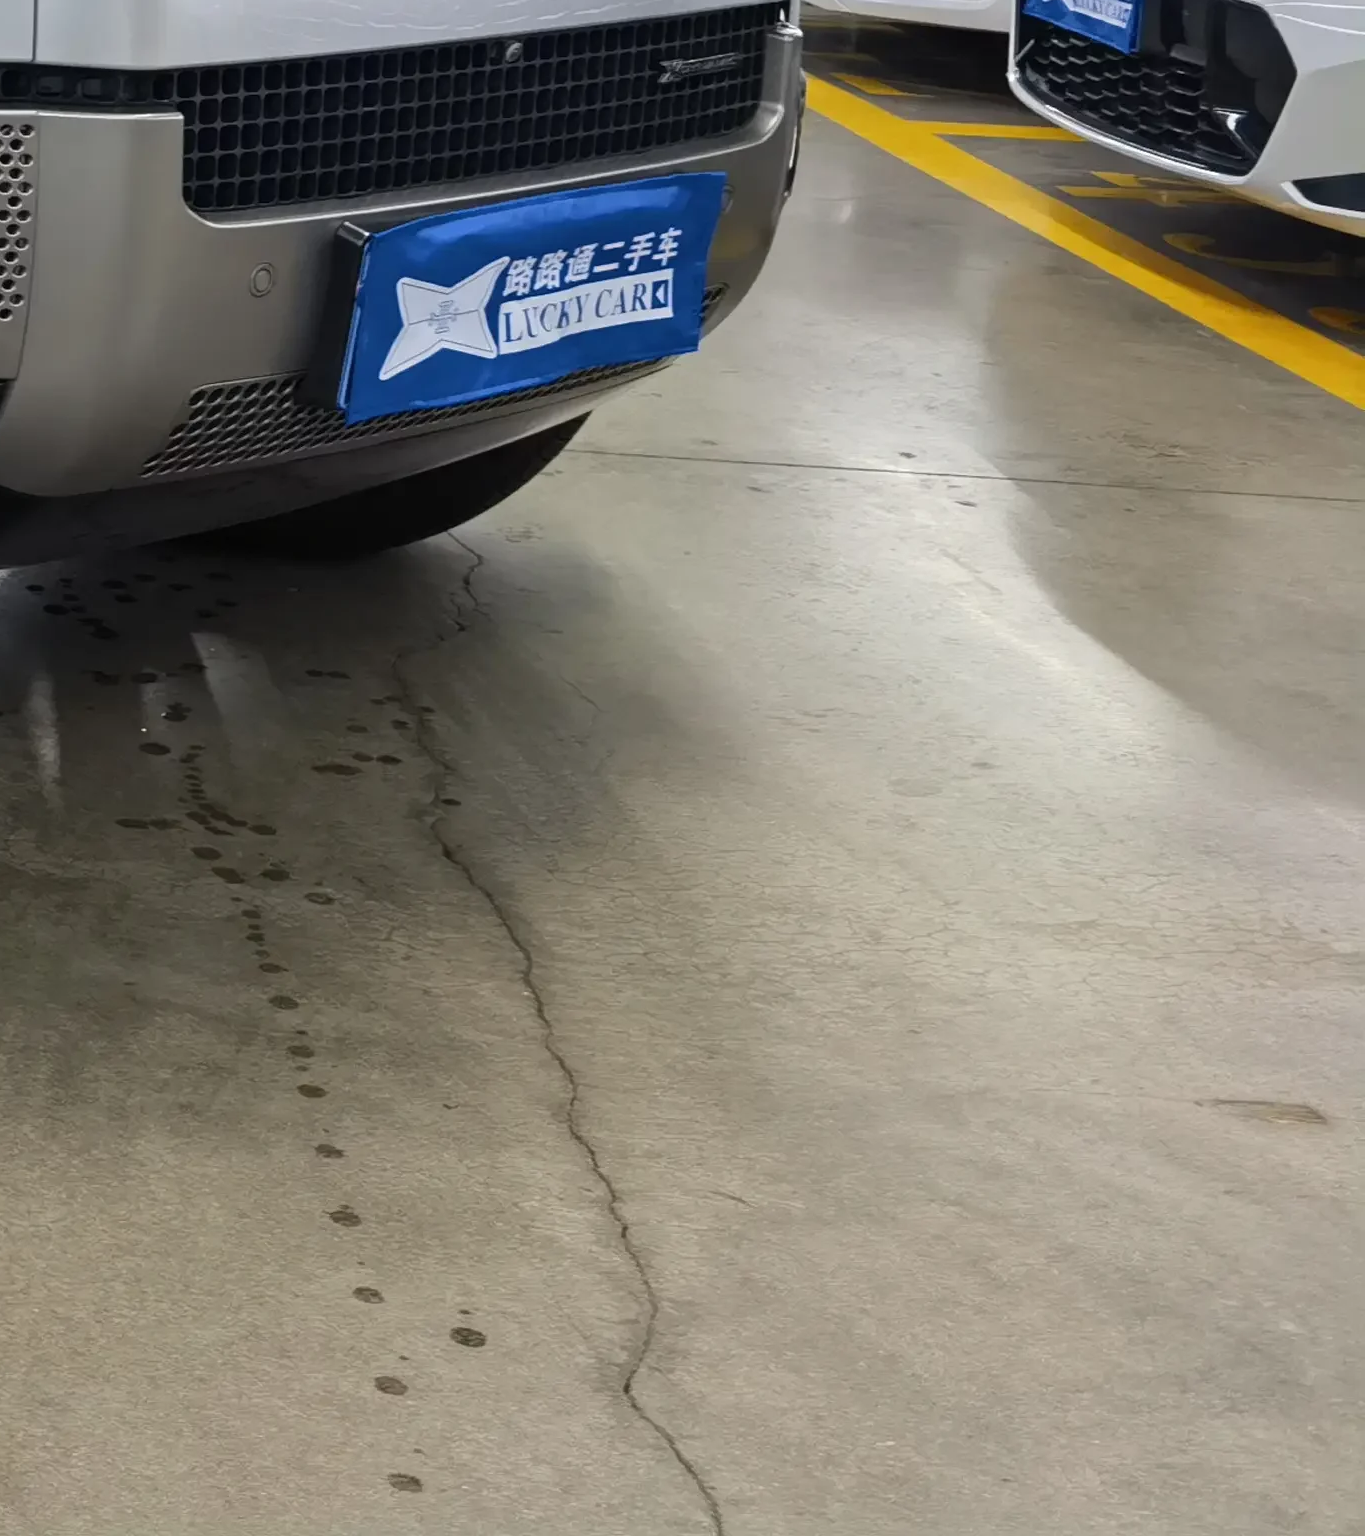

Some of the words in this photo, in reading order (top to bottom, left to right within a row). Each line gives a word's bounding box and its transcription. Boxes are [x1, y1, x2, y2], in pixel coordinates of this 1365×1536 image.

[501, 226, 684, 297] 路路通二手车
[502, 291, 591, 343] LUCKY
[594, 282, 648, 319] CAR
